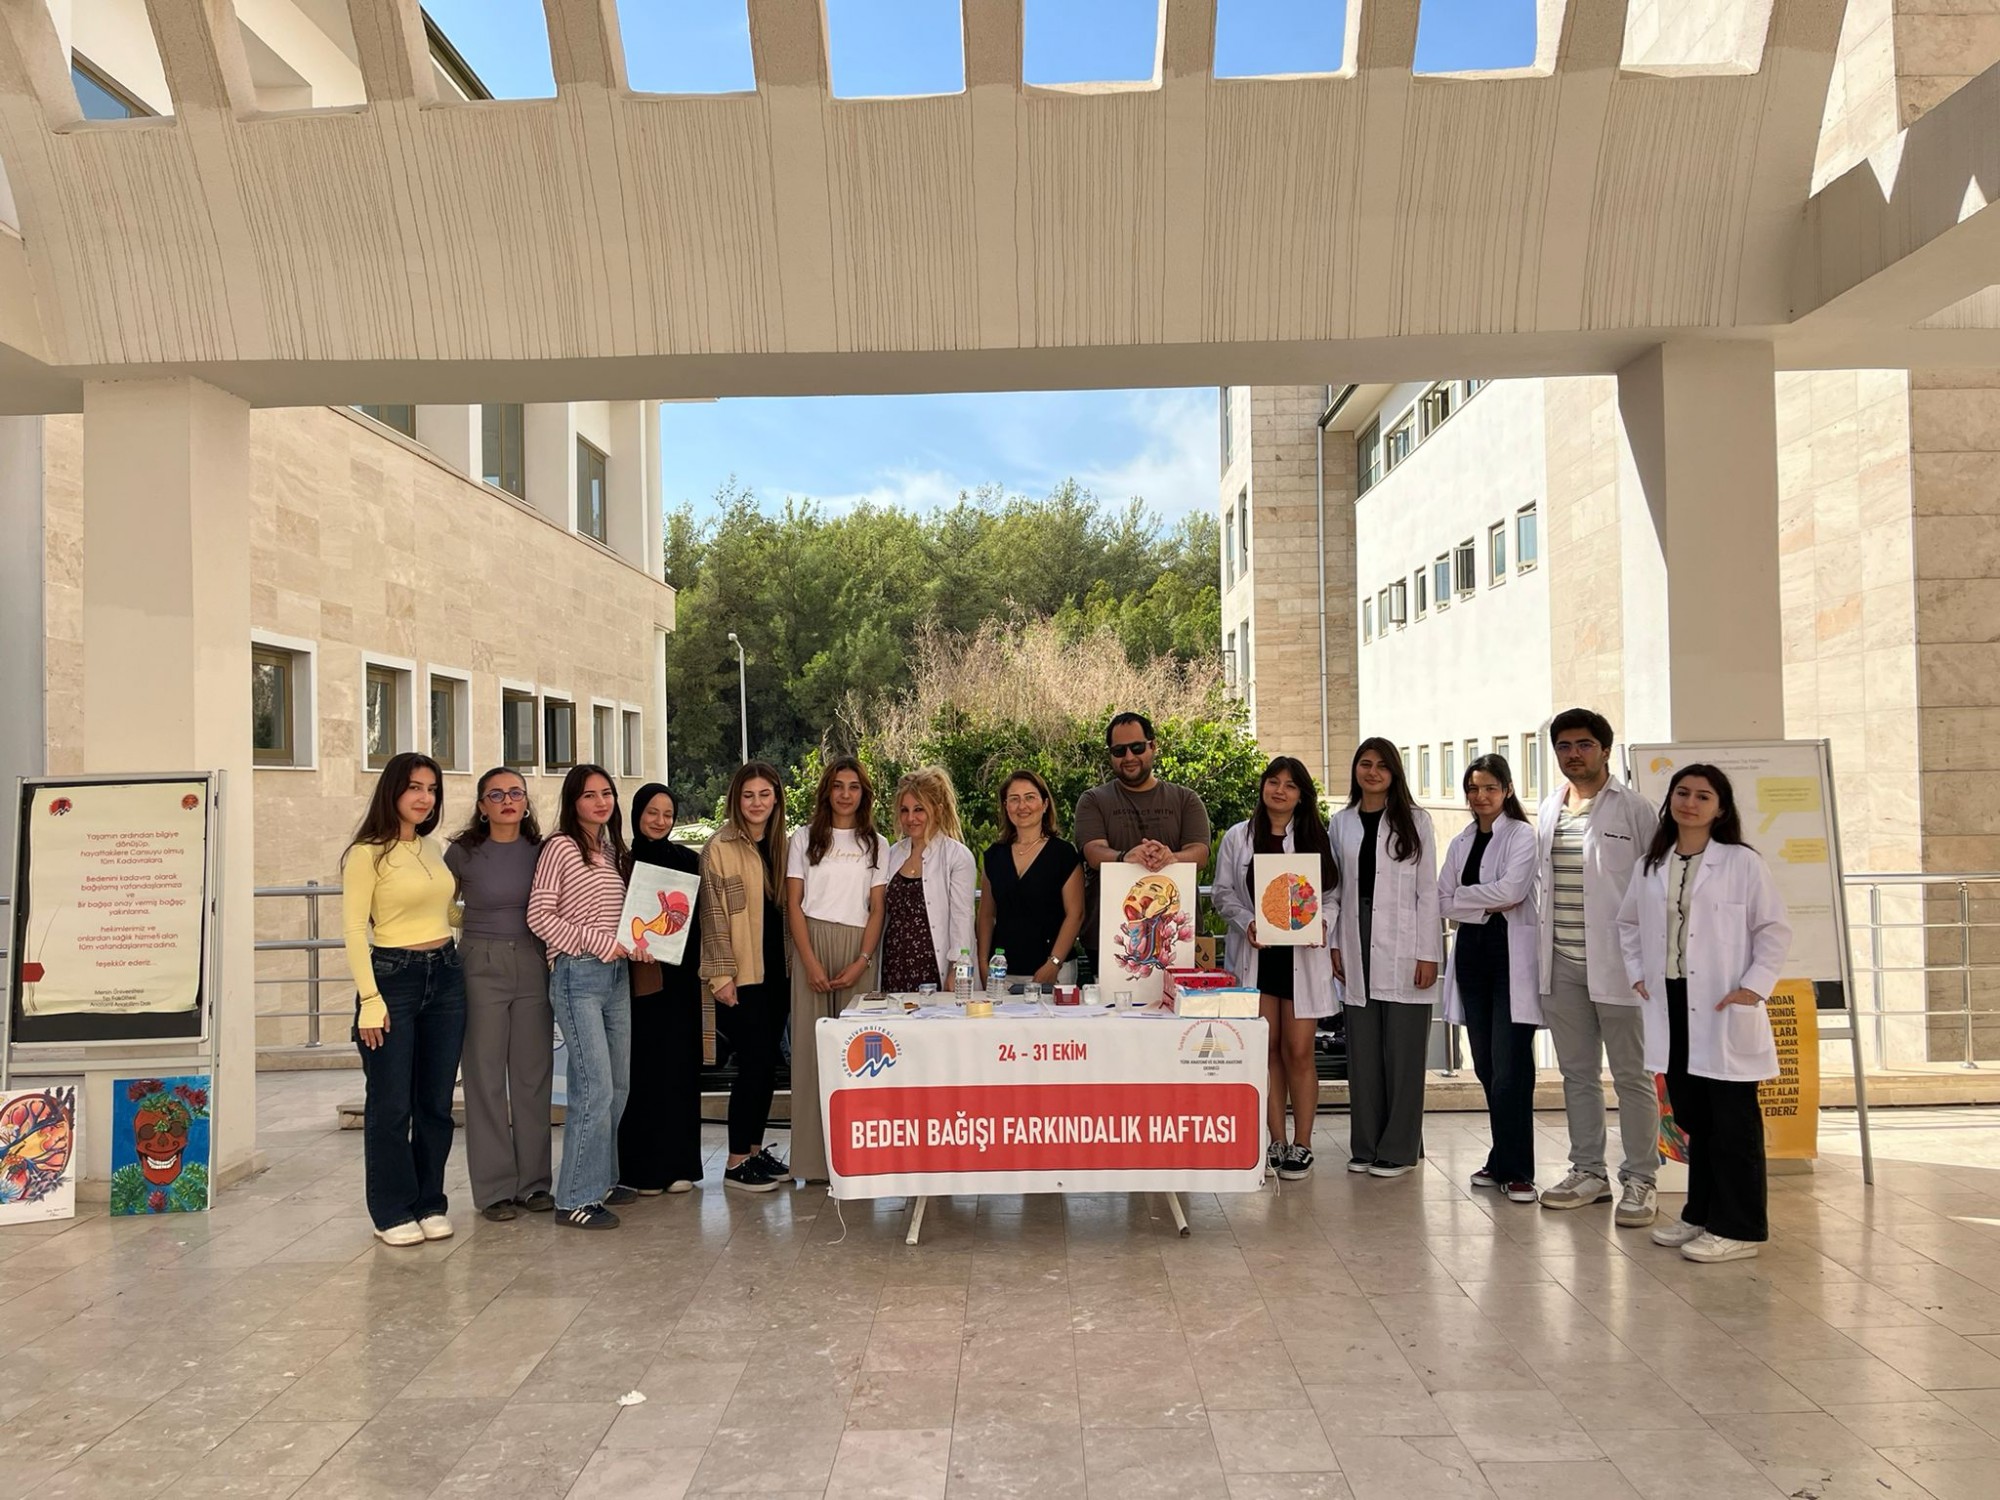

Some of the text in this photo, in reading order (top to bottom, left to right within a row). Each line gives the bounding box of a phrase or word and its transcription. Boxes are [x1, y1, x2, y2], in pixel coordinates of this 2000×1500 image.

[155, 831, 179, 839] bilgiye
[80, 849, 128, 857] hayattakilere
[130, 848, 162, 857] Cansuyu
[81, 884, 118, 892] bağışlamış
[88, 901, 112, 909] bağışa
[96, 960, 126, 968] teşekkür
[844, 1025, 894, 1046] ÜNİVERSİTESİ
[1774, 1027, 1798, 1037] LARA
[998, 1044, 1016, 1061] 24
[1033, 1044, 1047, 1061] 31
[1053, 1040, 1087, 1061] EKİM
[1780, 1067, 1799, 1076] RINA
[1777, 1087, 1799, 1096] ALAN
[851, 1111, 1236, 1152] BEDEN BAĞIŞI FARKINDALIK HAFTASI
